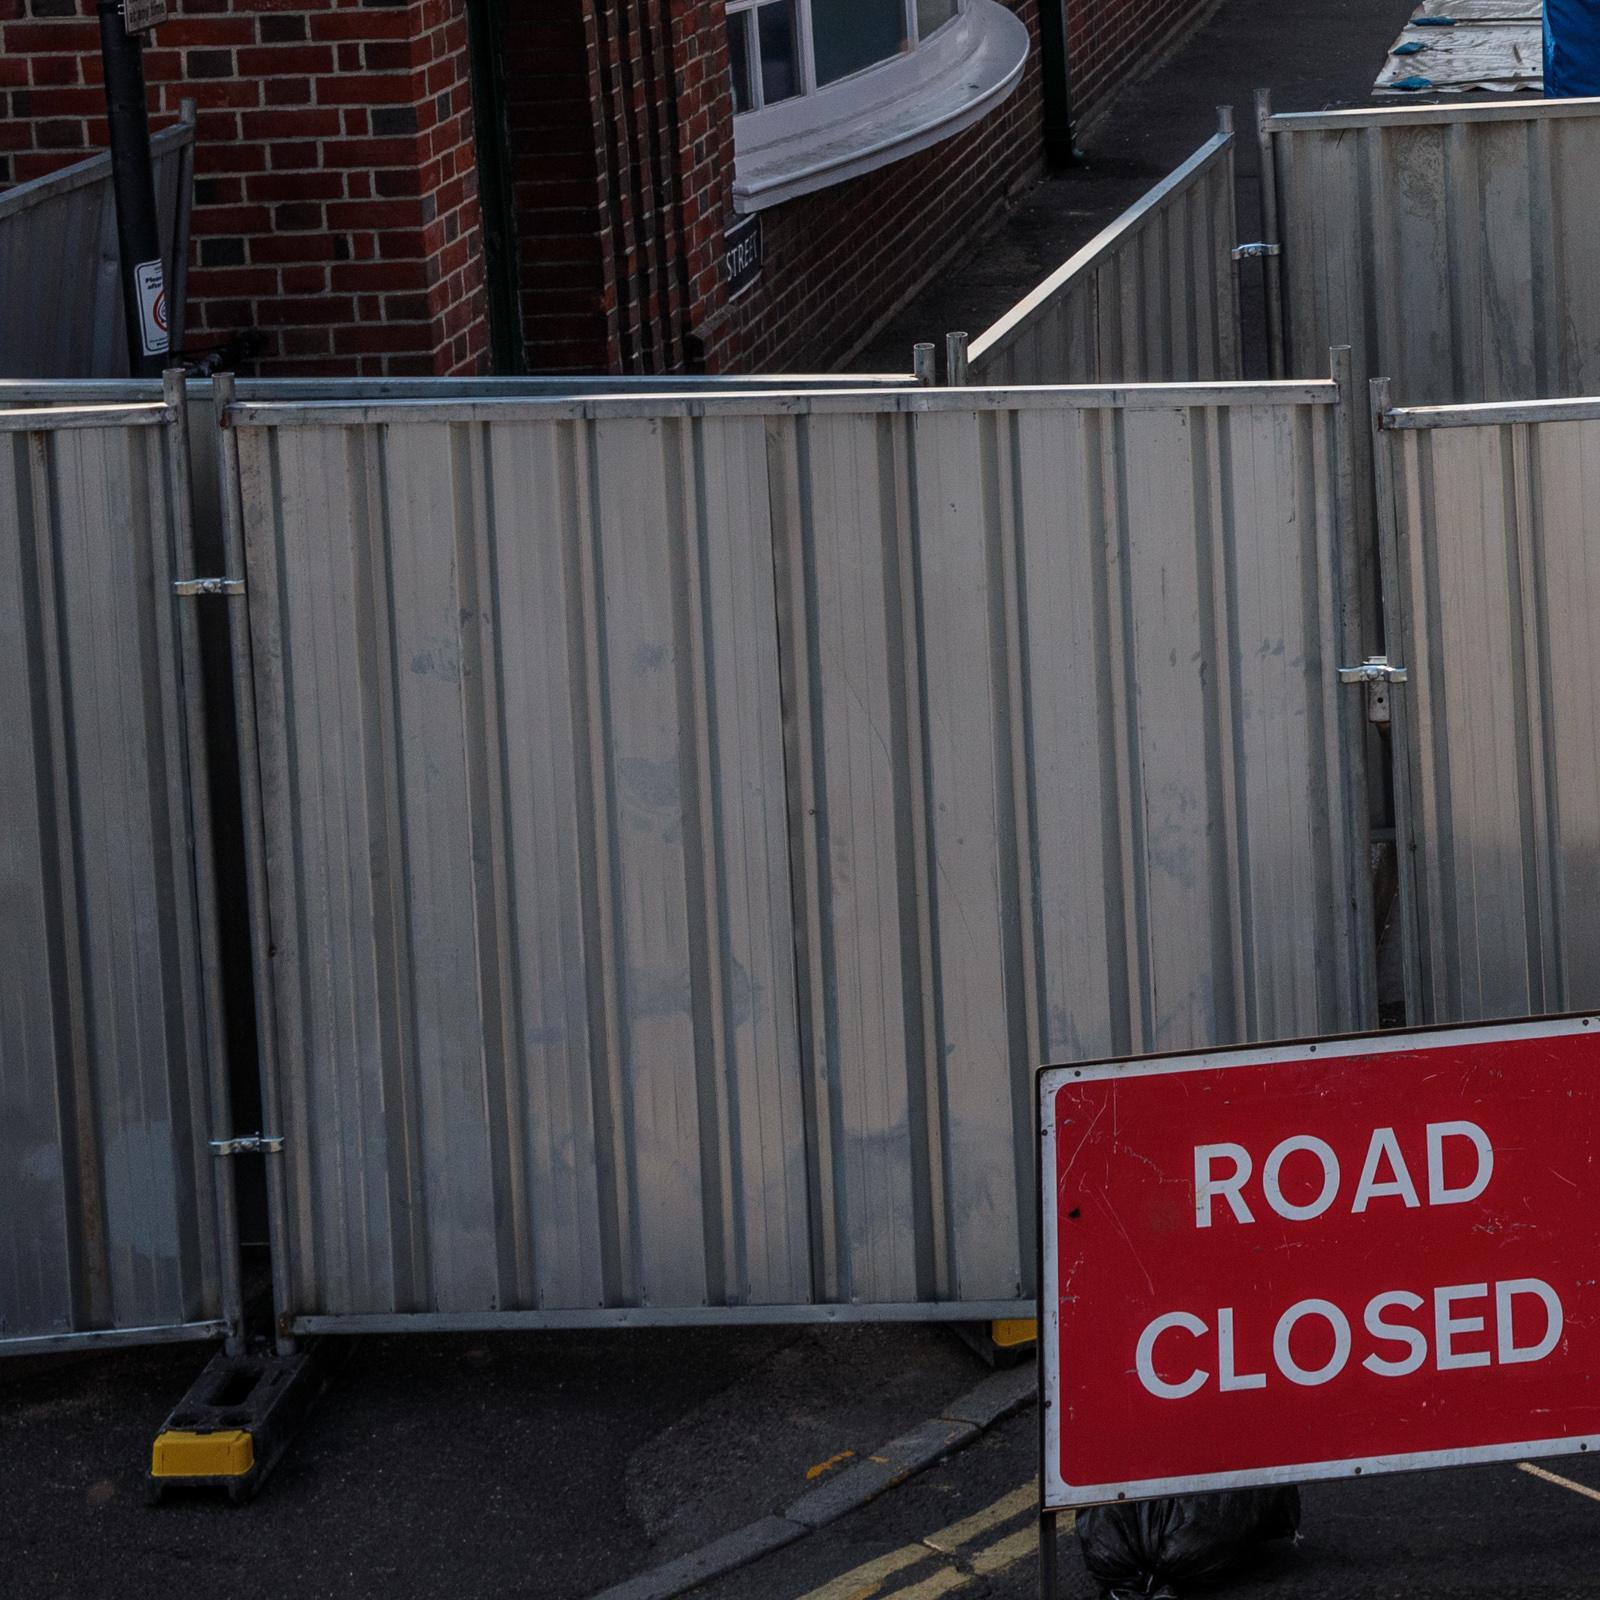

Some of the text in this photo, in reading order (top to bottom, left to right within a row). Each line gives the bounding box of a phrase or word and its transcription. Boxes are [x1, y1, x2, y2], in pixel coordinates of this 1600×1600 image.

[726, 230, 758, 282] STREET
[1194, 1121, 1494, 1228] ROAD
[1135, 1277, 1564, 1400] CLOSED
